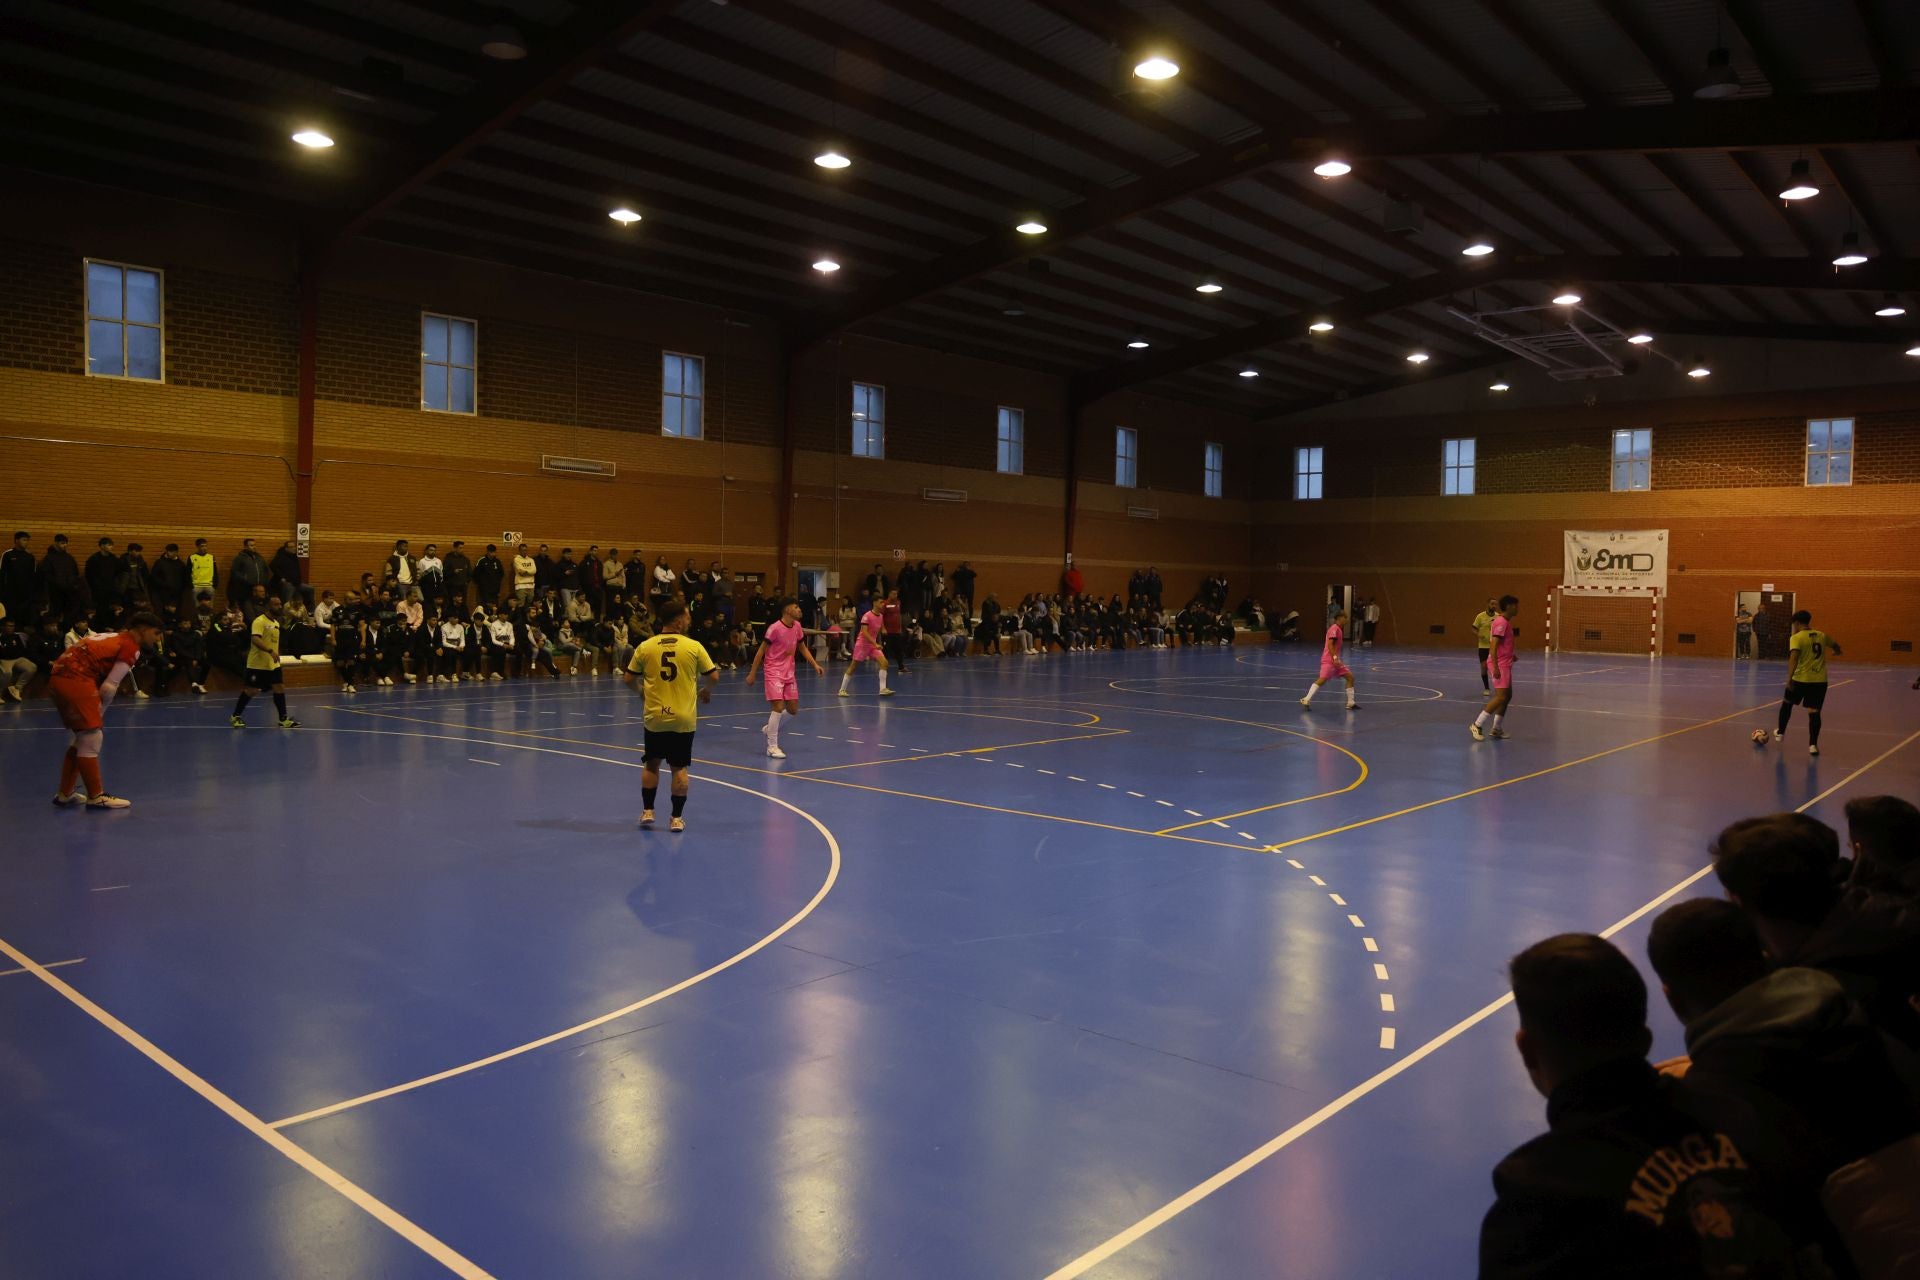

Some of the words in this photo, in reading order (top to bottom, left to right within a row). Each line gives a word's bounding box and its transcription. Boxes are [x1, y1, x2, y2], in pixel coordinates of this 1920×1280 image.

[660, 651, 678, 681] 5
[1812, 642, 1822, 660] 9
[1623, 1132, 1749, 1227] MURGA
